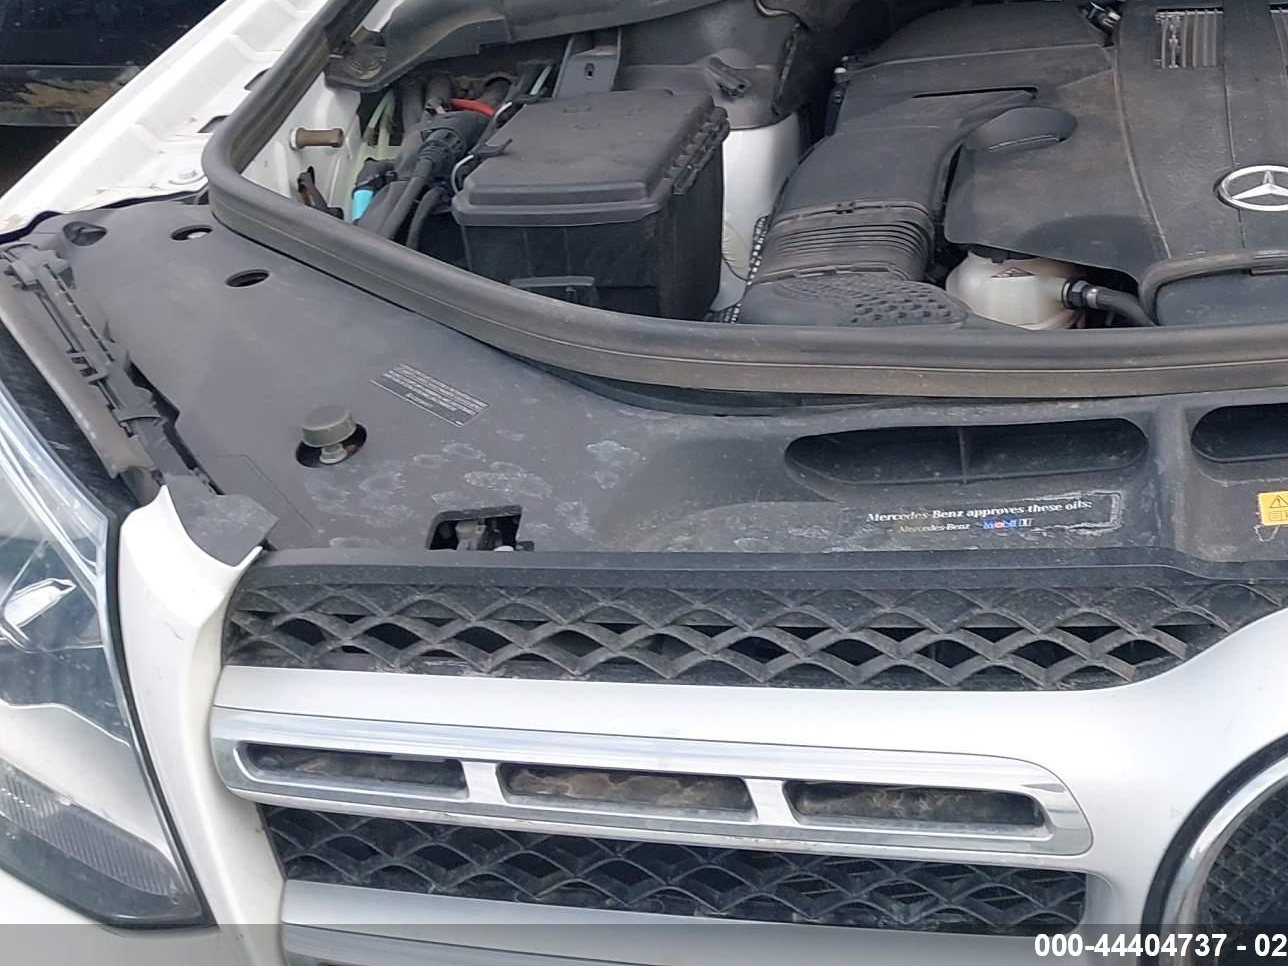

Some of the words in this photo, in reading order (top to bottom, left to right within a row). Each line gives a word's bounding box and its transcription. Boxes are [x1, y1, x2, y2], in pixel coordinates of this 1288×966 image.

[865, 509, 964, 522] Mercedes-Benz
[966, 505, 1025, 518] approves
[1027, 504, 1062, 513] these
